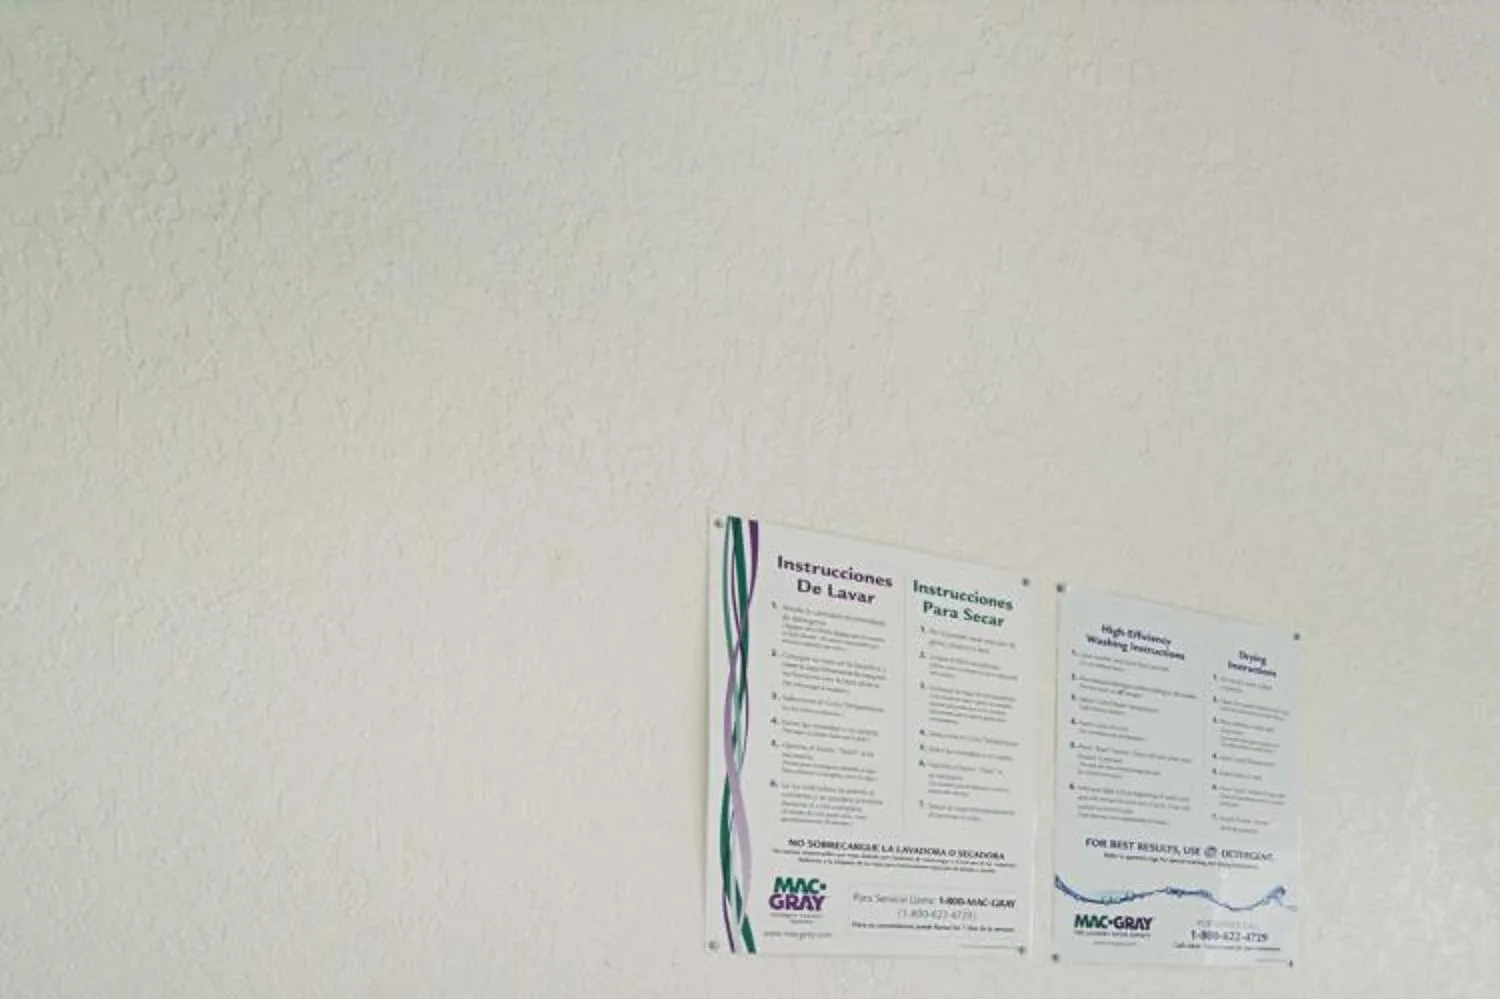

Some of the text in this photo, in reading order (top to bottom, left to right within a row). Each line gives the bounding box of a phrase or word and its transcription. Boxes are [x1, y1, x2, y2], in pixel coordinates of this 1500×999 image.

[777, 555, 893, 588] Instrucciones
[797, 579, 876, 604] De Lavar
[913, 579, 1013, 611] Instrucciones
[923, 600, 1005, 627] Para Secar
[1086, 633, 1128, 653] Washing
[1239, 650, 1267, 667] Drying
[768, 893, 825, 911] GRAY
